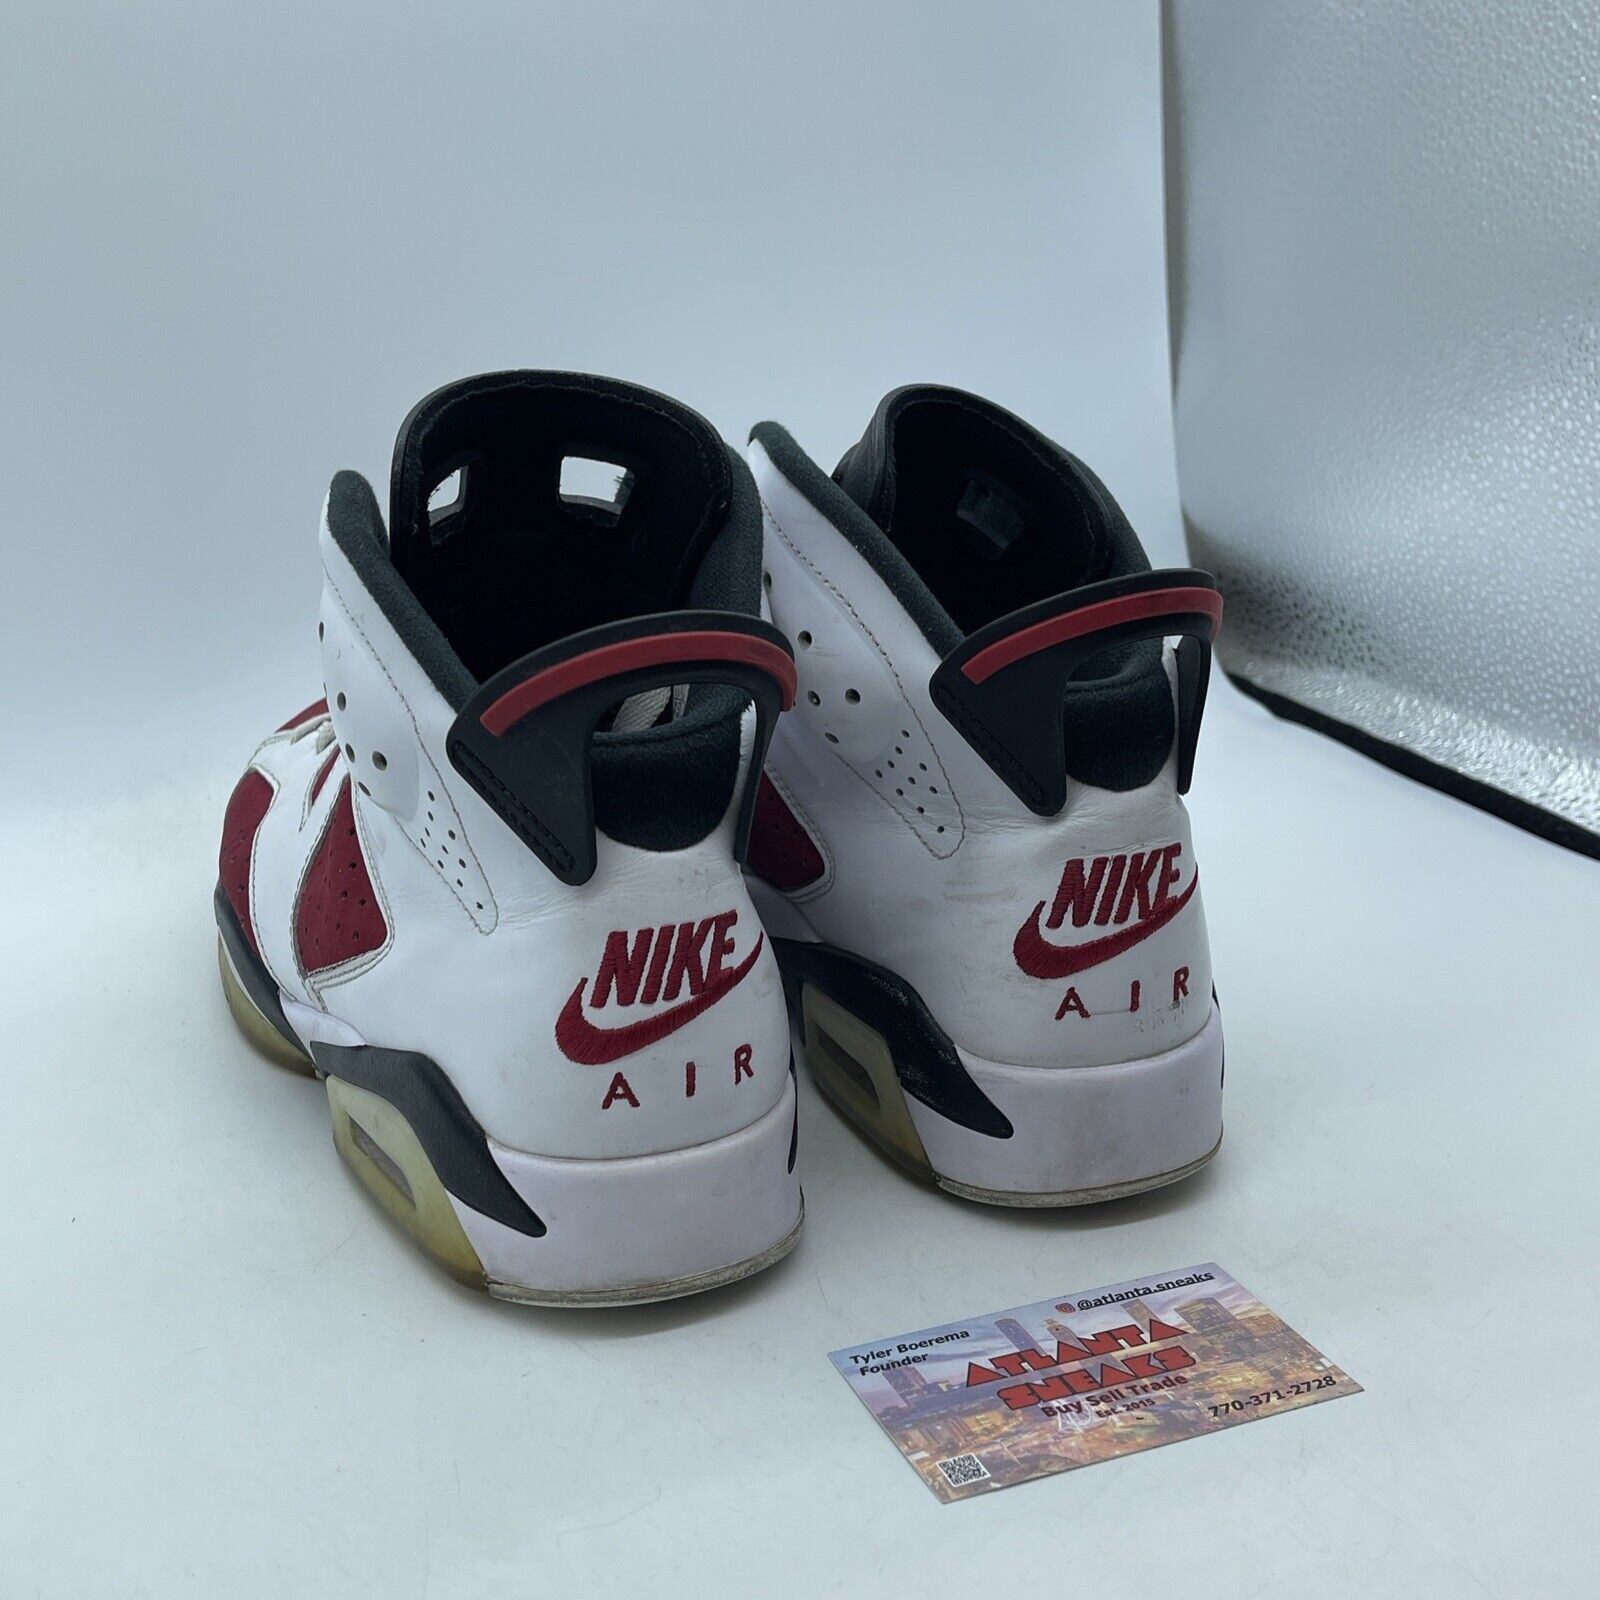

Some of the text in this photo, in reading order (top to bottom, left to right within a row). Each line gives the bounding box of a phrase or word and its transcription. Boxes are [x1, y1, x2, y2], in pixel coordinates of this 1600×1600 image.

[1045, 842, 1182, 929] NIKE
[589, 909, 738, 1008] NIKE
[1054, 966, 1190, 1020] AIR
[602, 1043, 754, 1110] AIR
[1077, 1270, 1215, 1311] @atlanta.sneaks
[849, 1329, 971, 1366] Tyler Boerema
[859, 1352, 929, 1377] Founder
[966, 1318, 1190, 1388] ATLANTA
[997, 1345, 1197, 1411] SNEAKS
[1041, 1374, 1188, 1418] Buy Sell Trade
[1208, 1375, 1338, 1418] 770-371-2728
